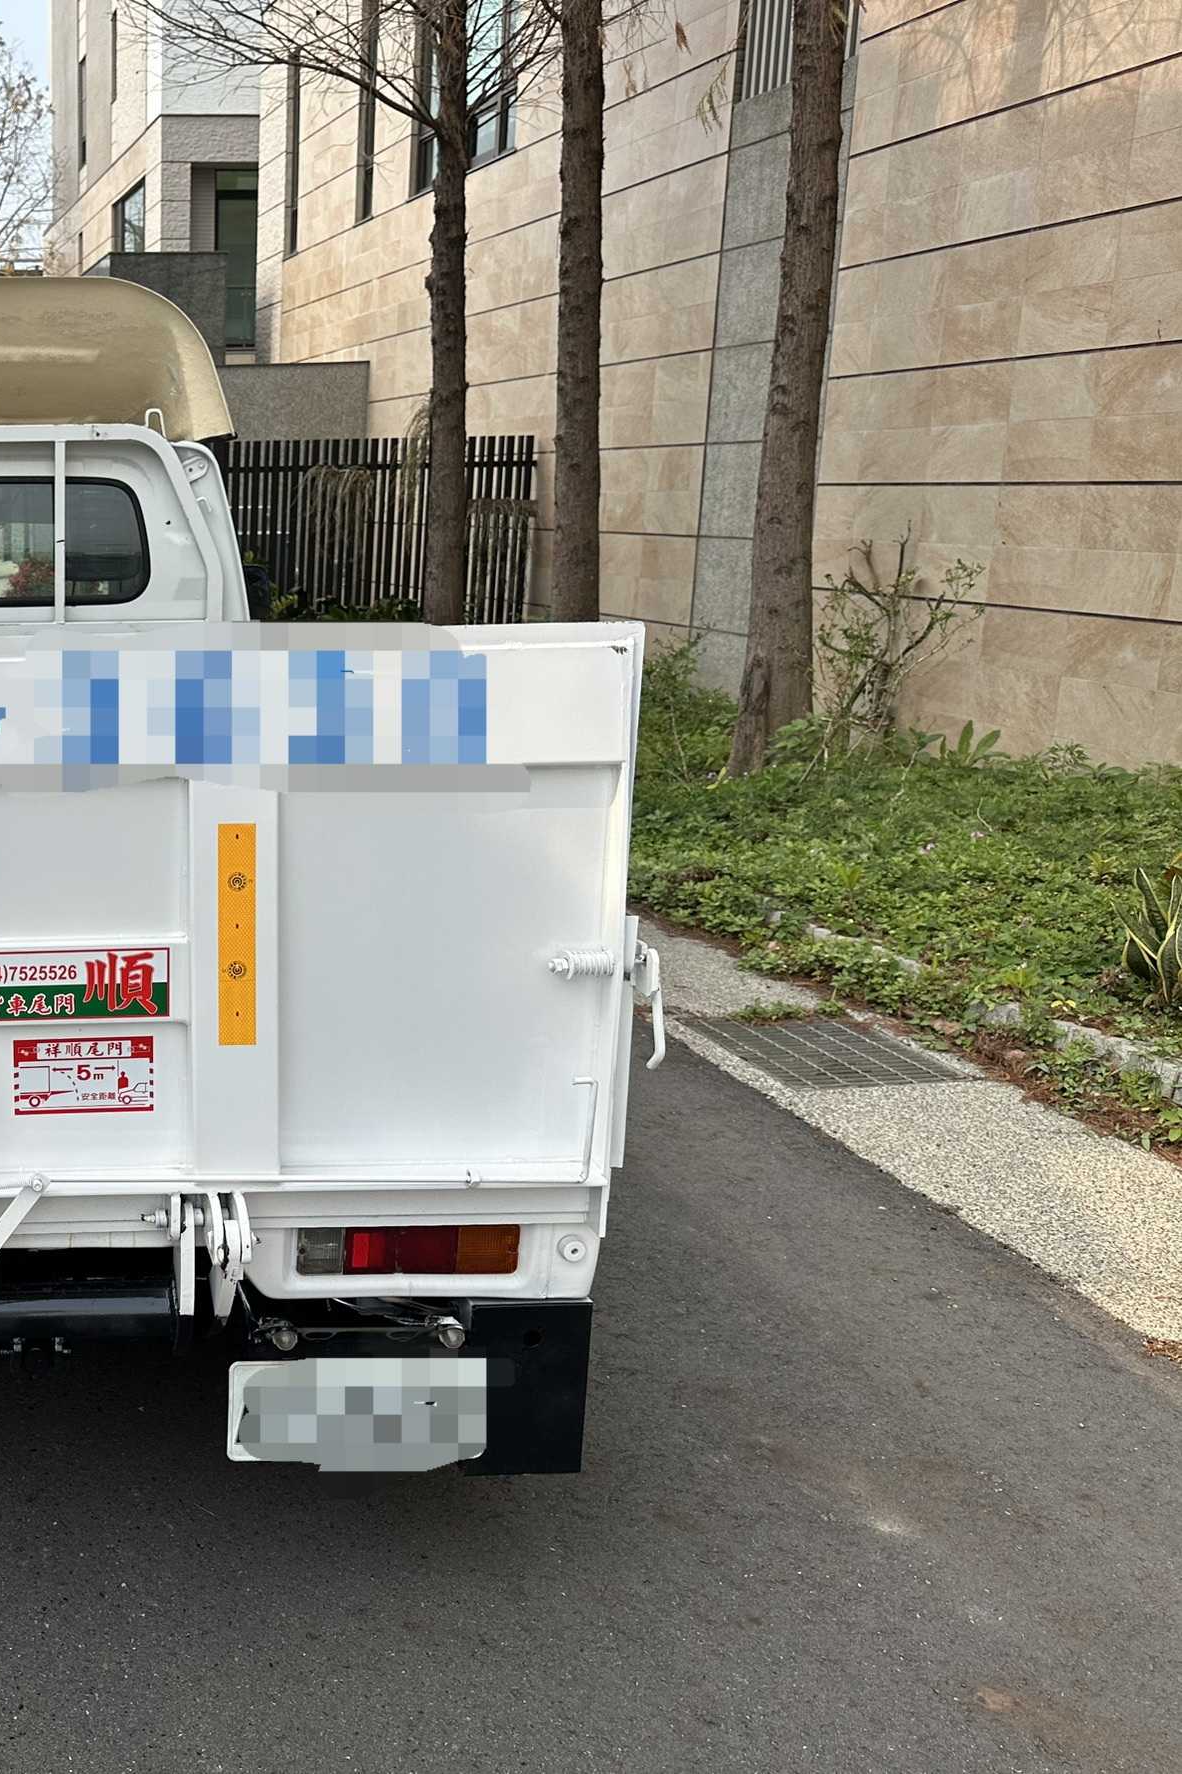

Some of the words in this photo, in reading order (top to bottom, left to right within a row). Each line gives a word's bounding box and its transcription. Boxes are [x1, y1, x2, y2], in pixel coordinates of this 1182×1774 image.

[83, 952, 158, 1016] 順
[45, 1042, 123, 1057] 祥順尾門
[81, 1091, 116, 1101] 安全距離
